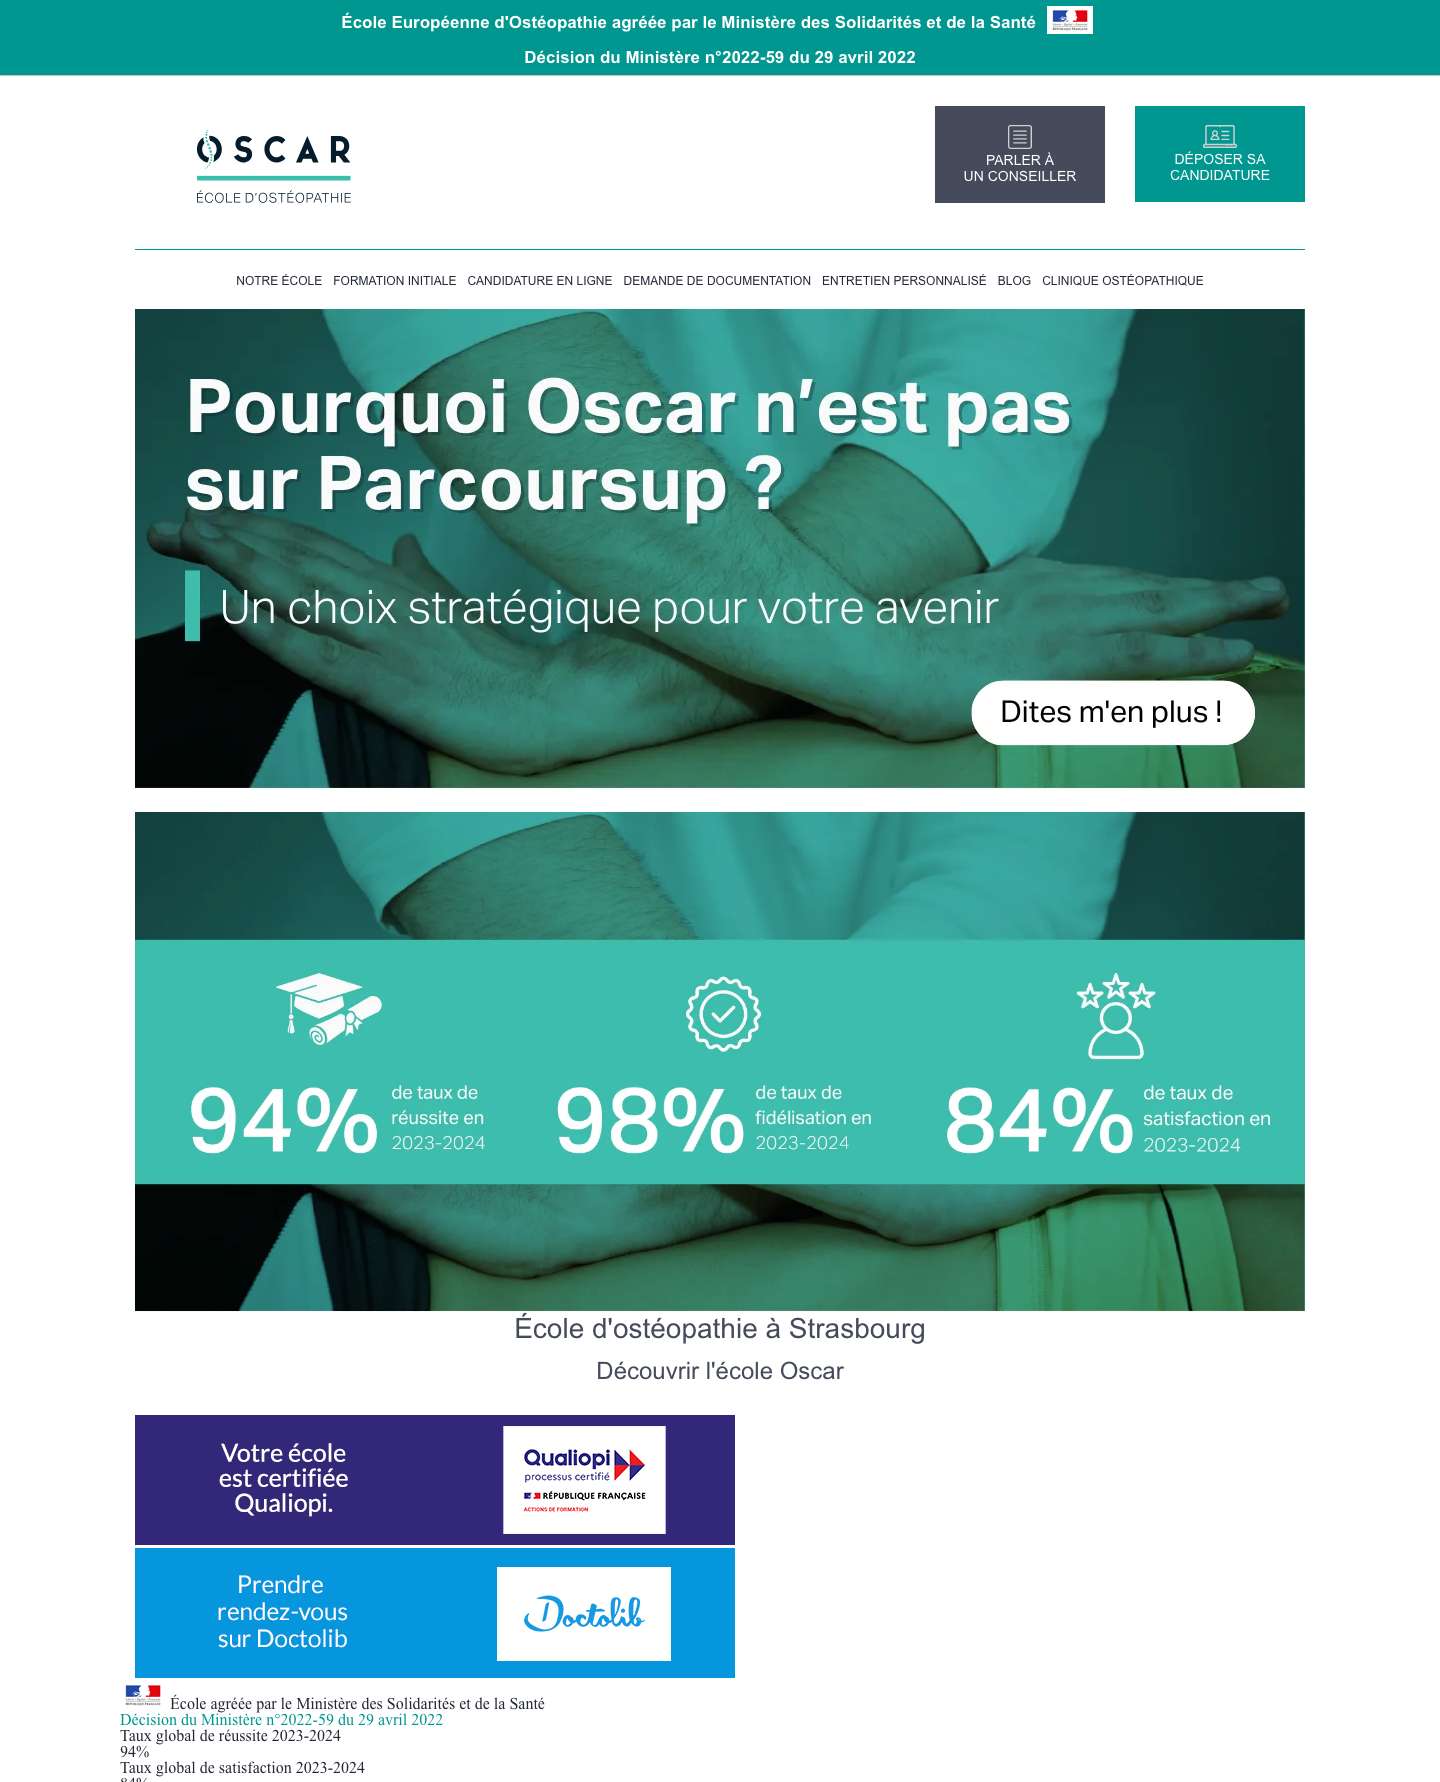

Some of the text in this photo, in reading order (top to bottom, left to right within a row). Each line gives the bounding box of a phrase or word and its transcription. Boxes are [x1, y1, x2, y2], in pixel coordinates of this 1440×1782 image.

[341, 11, 387, 30] École
[391, 15, 490, 33] Européenne
[494, 15, 607, 33] d'Ostéopathie
[611, 15, 667, 33] agréée
[671, 17, 699, 33] par
[702, 15, 717, 29] le
[721, 15, 797, 29] Ministère
[800, 15, 830, 30] des
[834, 15, 922, 30] Solidarités
[925, 15, 942, 30] et
[946, 15, 967, 31] de
[971, 15, 985, 30] la
[989, 15, 1037, 29] Santé
[196, 131, 351, 169] OSCAR
[986, 151, 1055, 166] PARLER À
[1174, 150, 1267, 165] DÉPOSER SA
[963, 170, 1077, 182] UN CONSEILLER
[1170, 169, 1271, 181] CANDIDATURE
[196, 189, 352, 204] ÉCOLE D’OSTÉOPATHIE
[236, 273, 323, 286] NOTRE ÉCOLE
[191, 378, 1069, 446] Pourquoi Oscar n’est pas
[188, 456, 781, 523] sur Parcoursup ?
[223, 590, 998, 632] Un choix stratégique pour votre avenir
[1001, 699, 1222, 728] Dites m'en plus !
[191, 1087, 377, 1153] 94%
[391, 1109, 485, 1126] réussite en
[558, 1087, 743, 1153] 98%
[947, 1088, 1133, 1153] 84%
[391, 1135, 486, 1151] 2023-2024
[516, 1313, 924, 1344] École d'ostéopathie à Strasbourg
[523, 1448, 611, 1471] Qualiopi
[524, 1471, 611, 1484] processus certifié
[542, 1490, 647, 1501] RÉPUBLIQUE FRANÇAISE
[524, 1595, 645, 1632] Doctolib
[120, 1728, 342, 1746] Taux global de réussite 2023-2024
